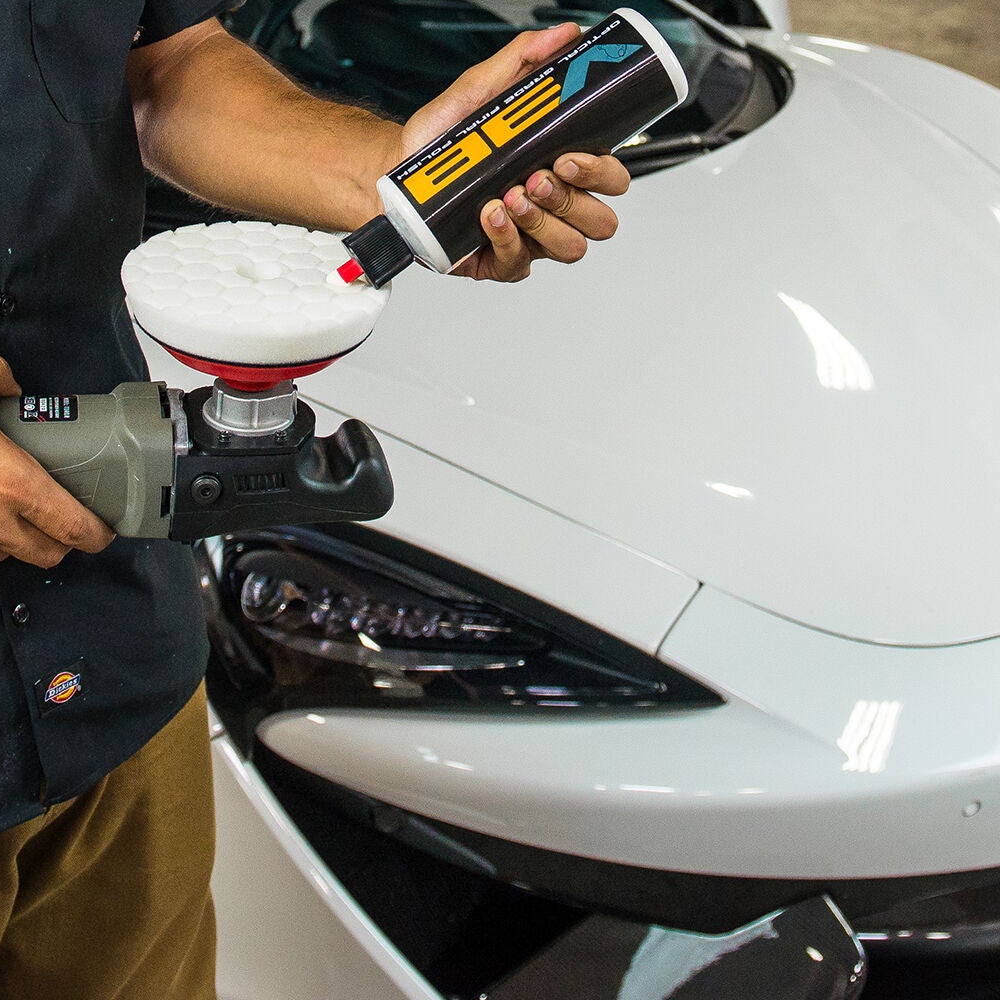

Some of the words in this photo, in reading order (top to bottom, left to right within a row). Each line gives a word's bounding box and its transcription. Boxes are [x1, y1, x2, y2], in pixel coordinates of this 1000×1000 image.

[557, 19, 621, 65] OPTICAL
[503, 66, 555, 105] GRADE
[402, 43, 644, 206] V38
[455, 105, 501, 138] FINAL
[396, 140, 453, 181] POLISH
[48, 678, 78, 698] Dickies
